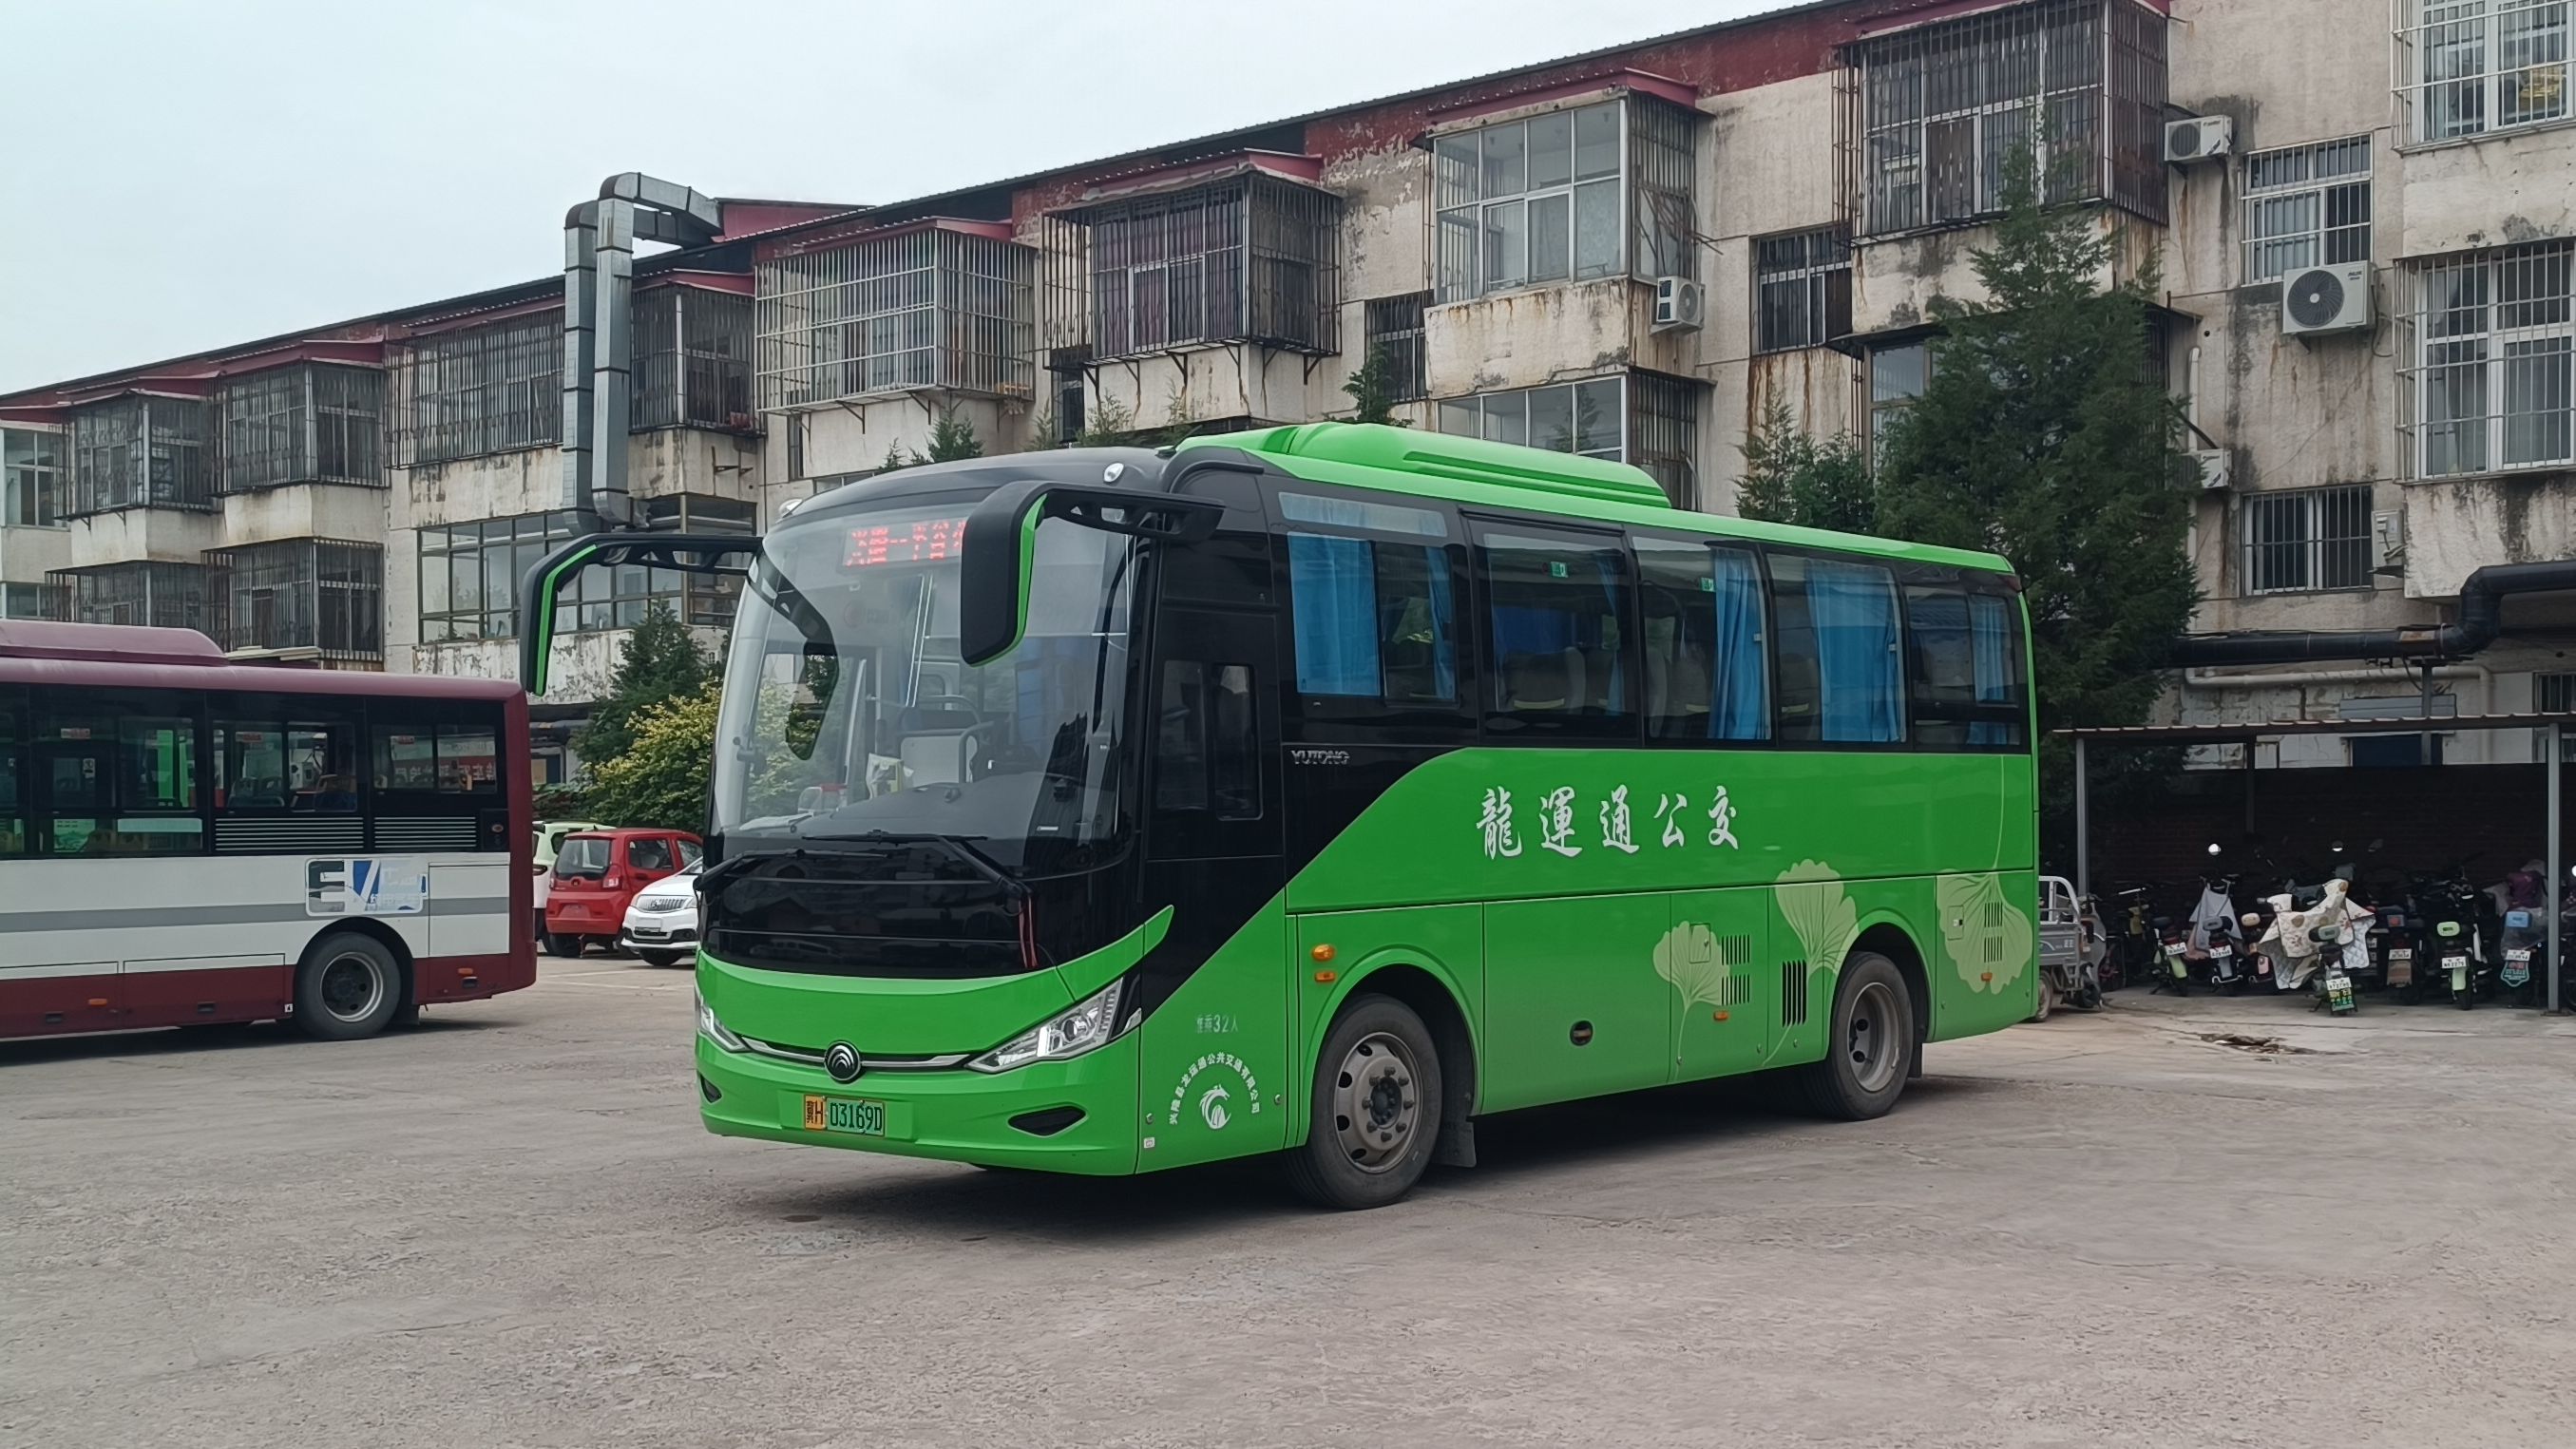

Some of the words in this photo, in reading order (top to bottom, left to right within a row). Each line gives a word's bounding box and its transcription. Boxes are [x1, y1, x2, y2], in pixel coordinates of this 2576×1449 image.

[1290, 750, 1350, 765] YUTONG
[1476, 783, 1740, 860] 龍運通公交
[1169, 1052, 1261, 1126] 兴隆县龙运通公共交通有限公司
